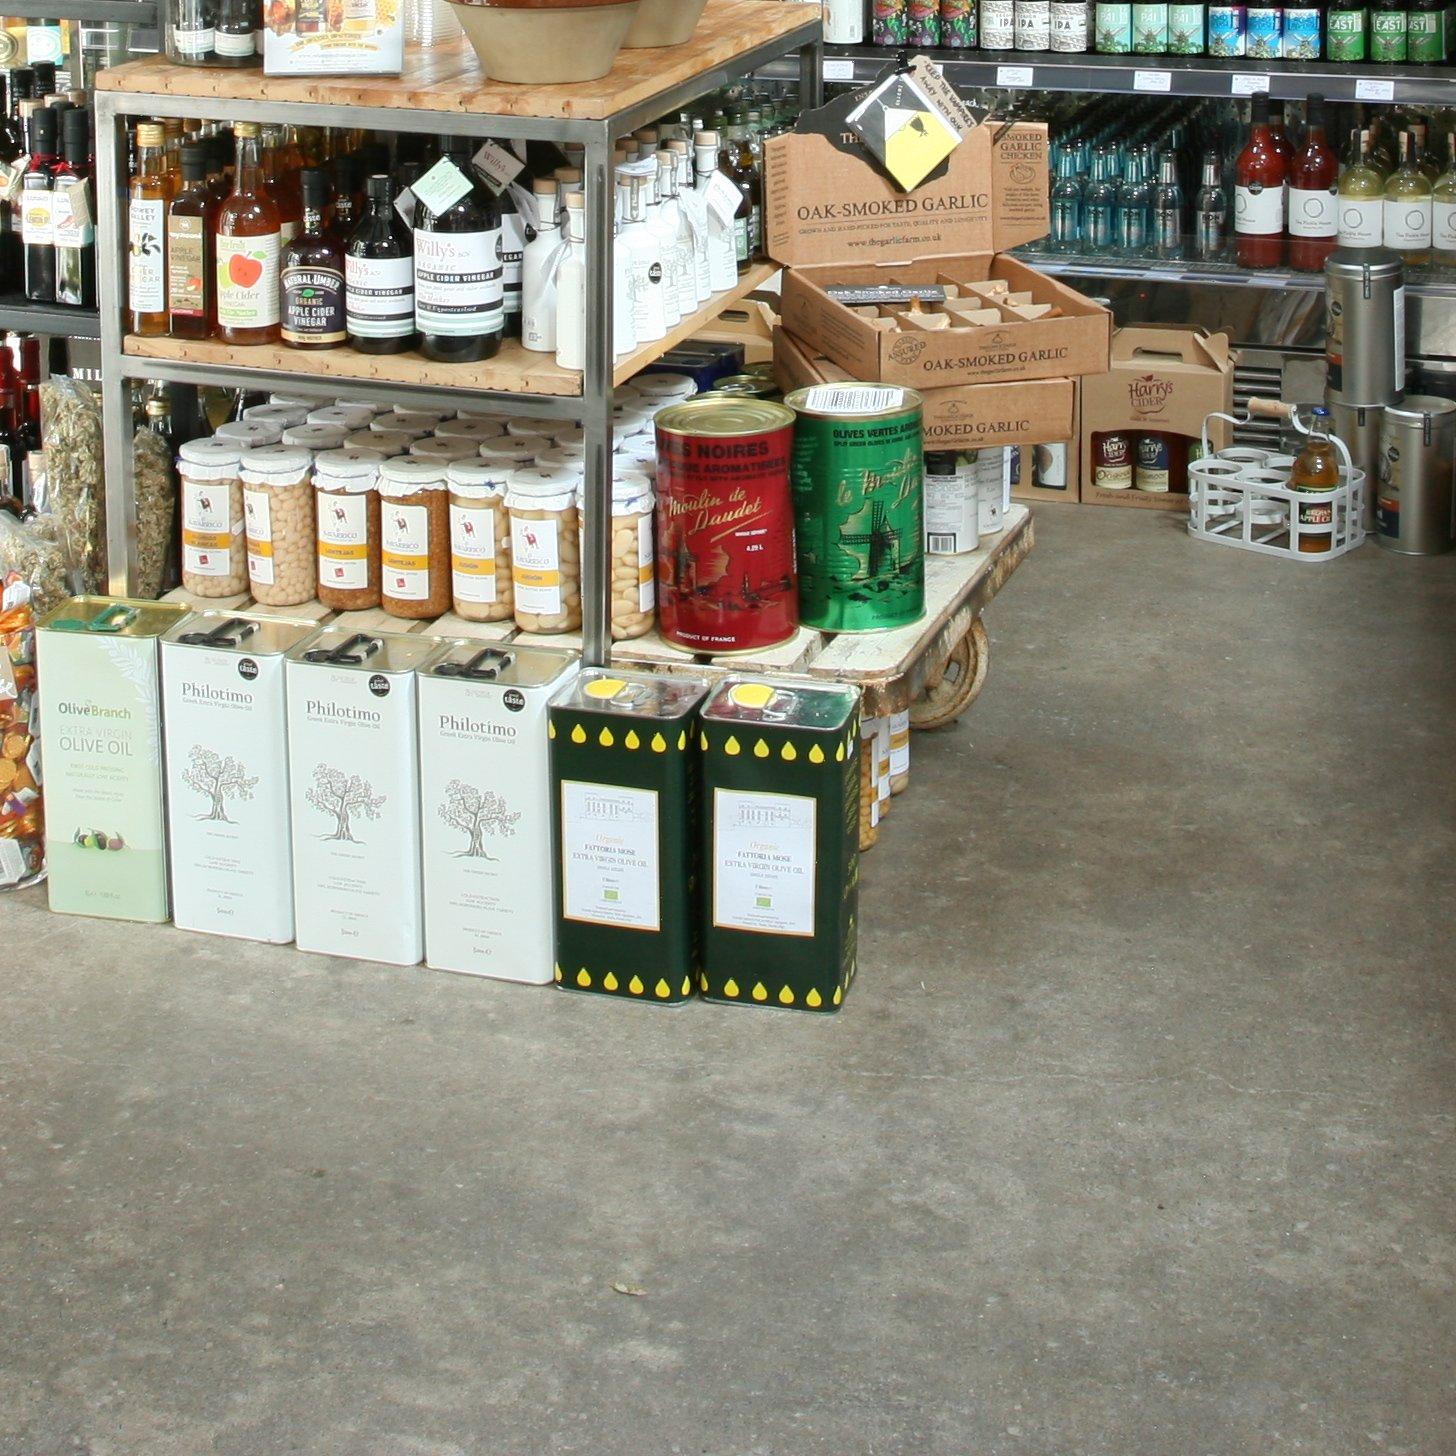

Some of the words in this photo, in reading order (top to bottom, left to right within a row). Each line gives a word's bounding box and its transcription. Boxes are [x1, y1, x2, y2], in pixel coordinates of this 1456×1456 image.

[1017, 18, 1034, 29] IPA
[1054, 20, 1072, 30] IPA
[1329, 19, 1353, 31] EAST
[1376, 19, 1402, 31] EAST
[1000, 133, 1042, 142] SMOKED
[1000, 143, 1042, 151] GARLIC
[1000, 151, 1043, 160] CHICKEN
[797, 198, 918, 221] OAK-SMOKED
[921, 194, 989, 211] GARLIC
[847, 234, 943, 247] www.thegarlicfarm.co.uk
[416, 237, 456, 261] Willy's
[418, 271, 435, 280] APPLE
[436, 273, 460, 282] CIDER
[462, 272, 494, 282] VINEGAR
[374, 288, 403, 296] VINEGAR
[294, 297, 324, 306] ORGANIC
[287, 306, 310, 317] APPLE
[311, 306, 336, 317] CIDER
[293, 317, 327, 327] VINEGAR
[923, 351, 1016, 372] OAK-SMOKED
[1018, 346, 1069, 362] GARLIC
[832, 429, 865, 439] OLIVES
[867, 427, 899, 438] VERTES
[976, 420, 1030, 434] GARLIC
[697, 440, 769, 458] NOIRES
[668, 488, 722, 518] Moulin
[729, 486, 747, 502] de
[711, 635, 736, 643] FRANCE
[181, 681, 253, 704] Philotimo
[58, 700, 131, 720] OliveBranch
[305, 699, 381, 723] Philotimo
[439, 715, 517, 737] Philotimo
[59, 725, 93, 739] EXTRA
[96, 726, 133, 742] VIRGIN
[59, 736, 104, 754] OLIVE
[107, 740, 133, 757] OIL
[572, 852, 592, 862] EXTRA
[593, 854, 616, 864] VIRGIN
[617, 857, 637, 866] OLIVE
[724, 859, 745, 868] EXTRA
[746, 861, 770, 871] VIRGIN
[771, 864, 792, 873] OLIVE
